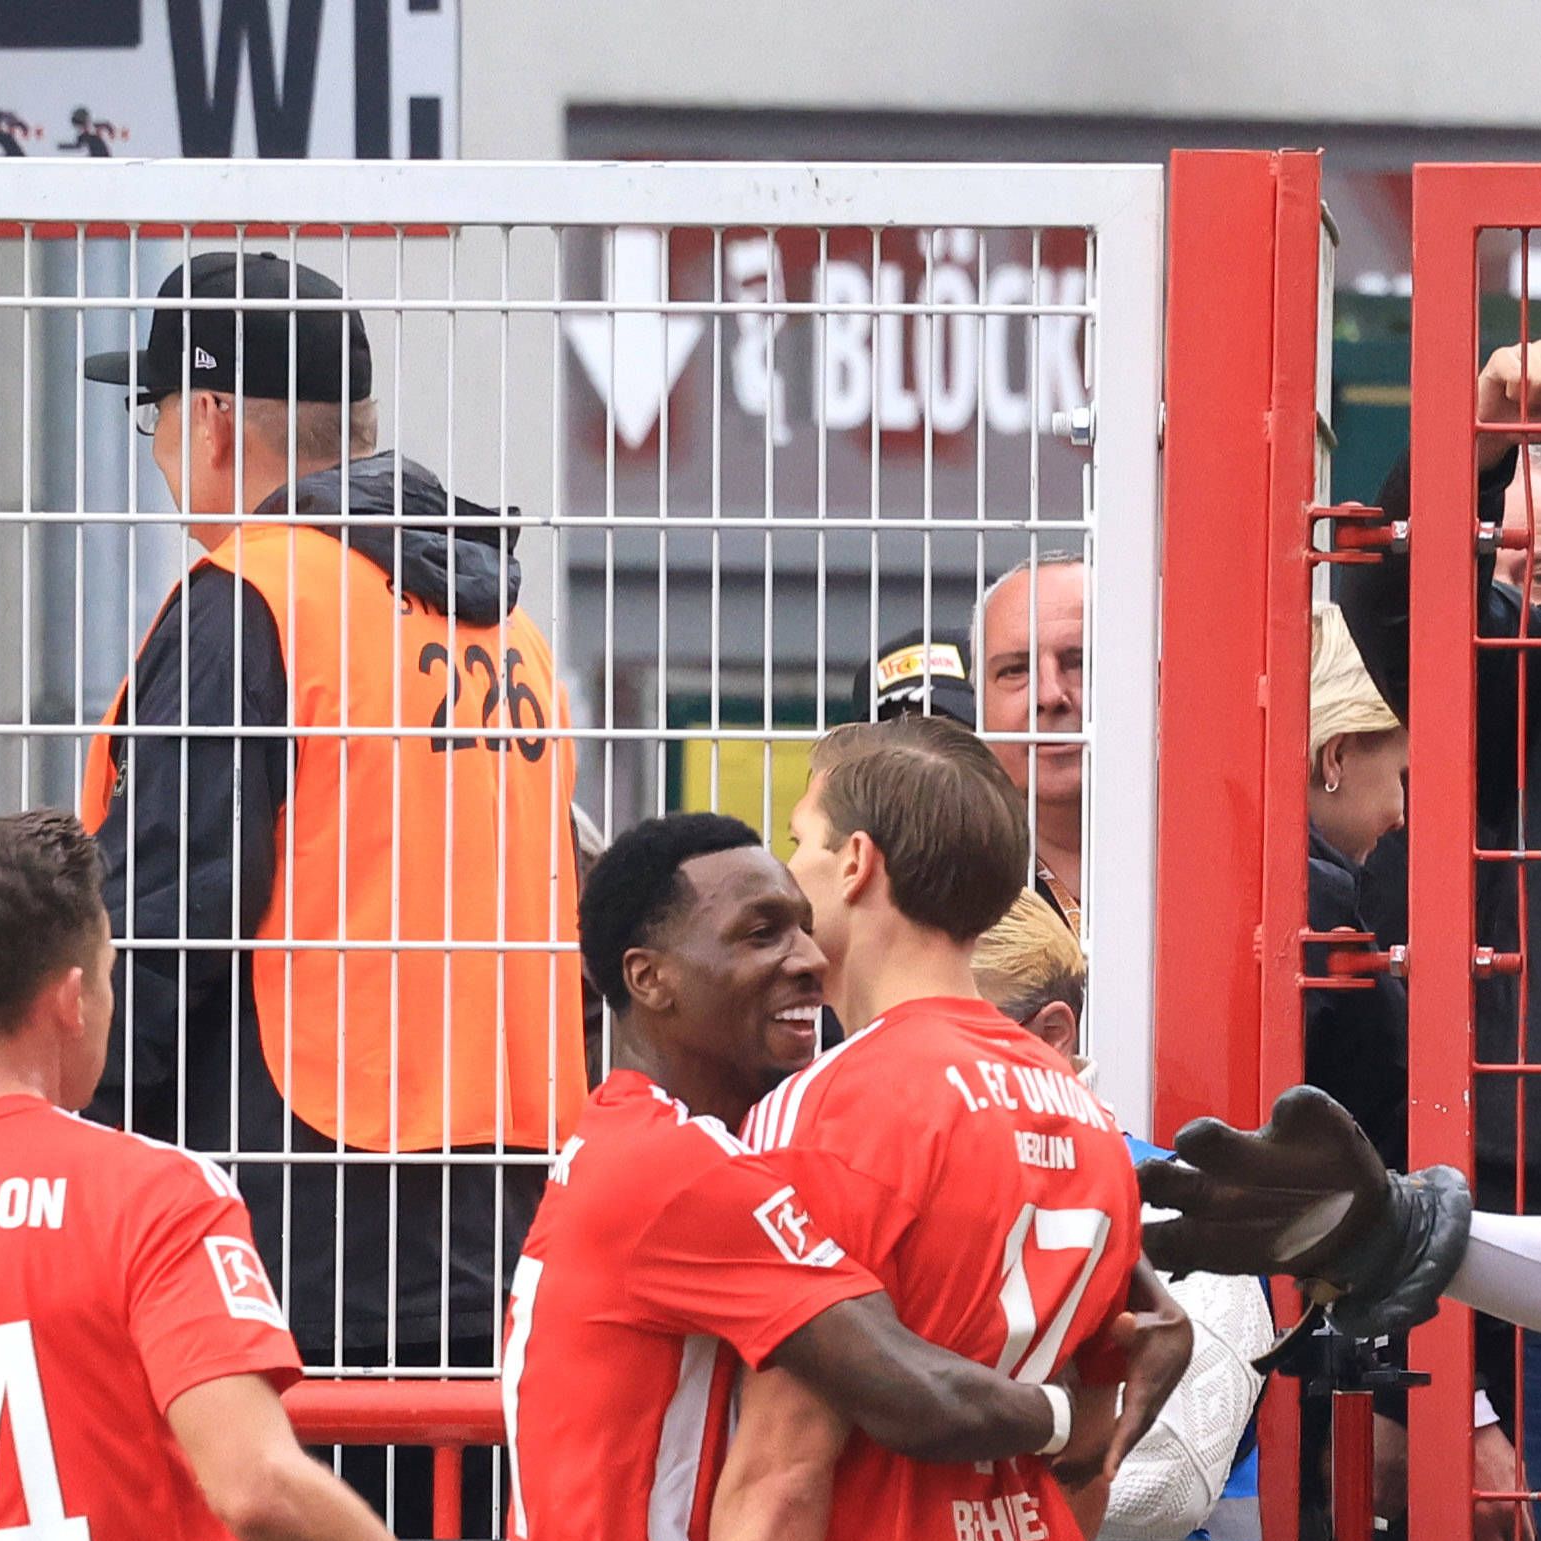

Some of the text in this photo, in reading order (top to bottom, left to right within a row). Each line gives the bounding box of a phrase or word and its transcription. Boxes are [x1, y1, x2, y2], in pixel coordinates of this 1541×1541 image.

[418, 642, 545, 763] 226
[976, 1060, 1019, 1111] FC
[1012, 1066, 1109, 1132] UNION
[998, 1203, 1111, 1388] 17
